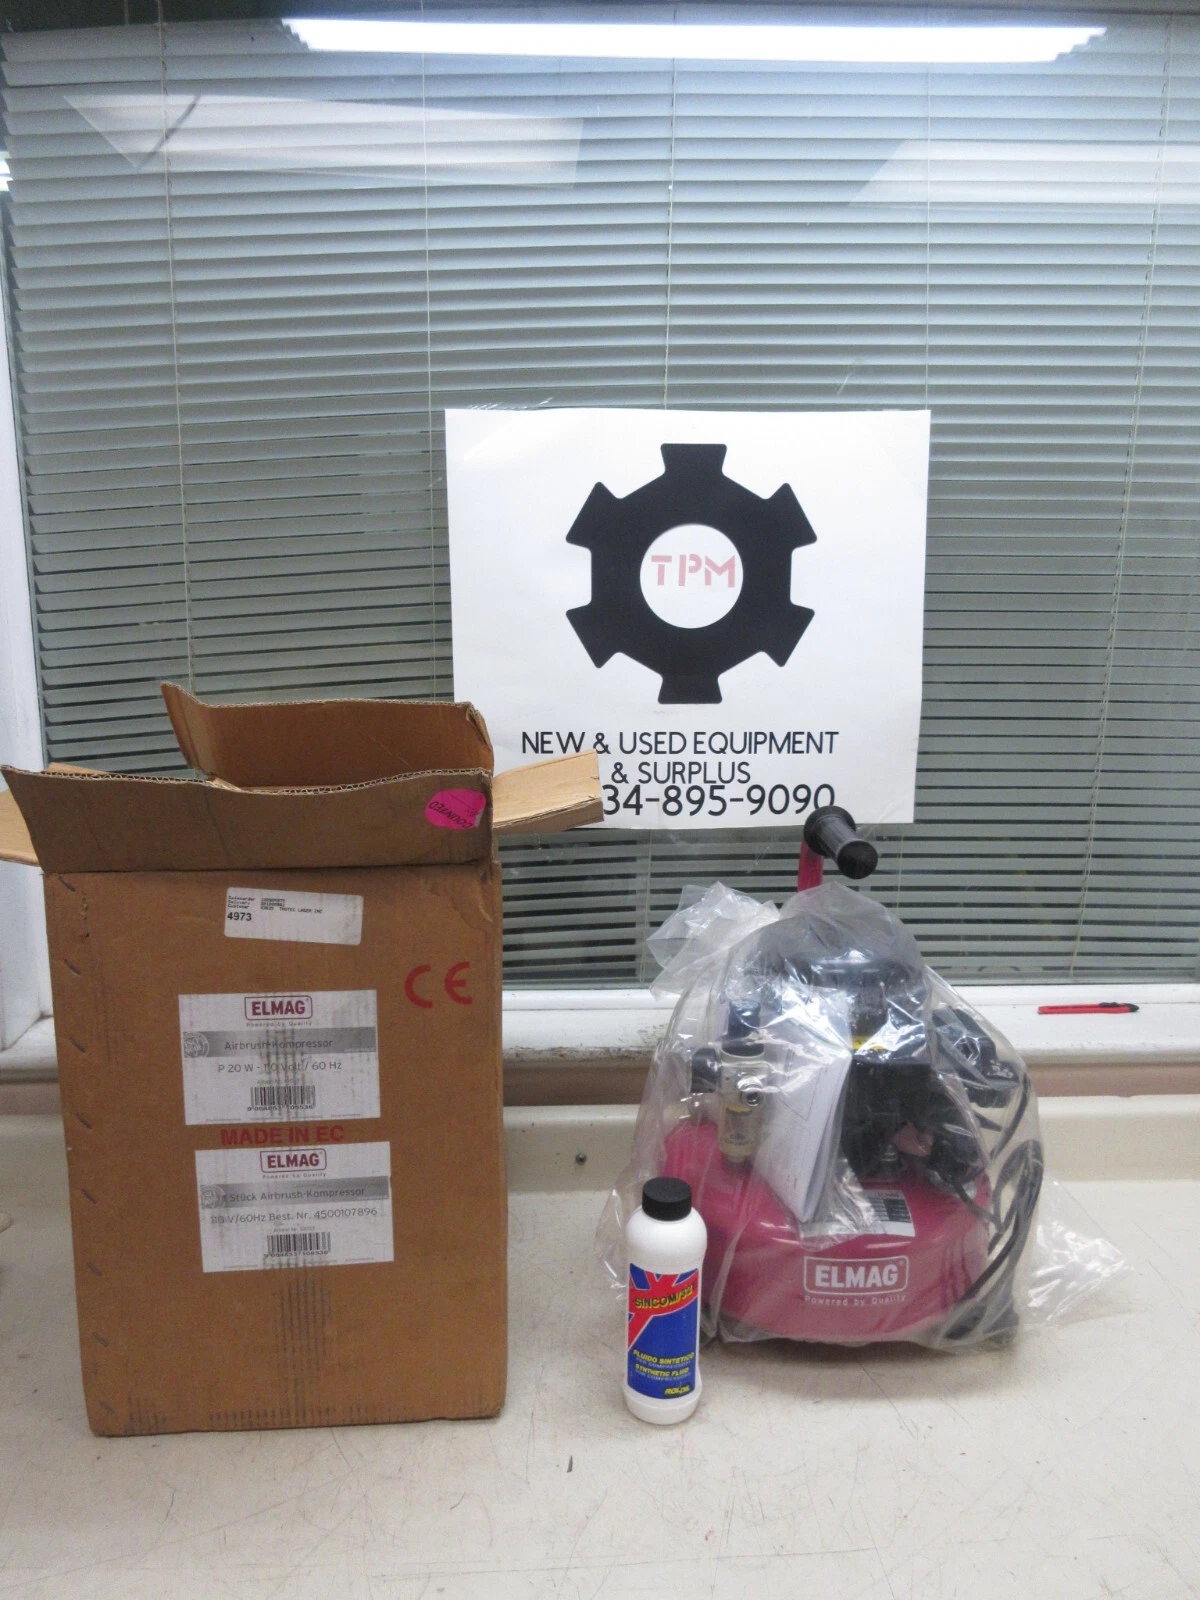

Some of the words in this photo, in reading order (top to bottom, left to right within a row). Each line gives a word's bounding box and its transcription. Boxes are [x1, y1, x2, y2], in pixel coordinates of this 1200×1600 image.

[651, 554, 735, 588] TPM
[522, 732, 585, 754] NEW
[594, 732, 610, 755] &
[619, 732, 687, 755] USED
[694, 731, 839, 755] EQUIPMENT
[611, 761, 629, 784] &
[638, 761, 751, 784] SURPLUS
[602, 783, 836, 816] 34-895-9090
[428, 801, 473, 829] COUNTED
[226, 911, 252, 921] 4973
[404, 961, 473, 1009] CE
[251, 999, 306, 1016] ELMAG
[217, 1064, 225, 1073] P
[228, 1063, 241, 1073] 20
[245, 1063, 254, 1072] W
[312, 1062, 326, 1071] 60
[329, 1061, 342, 1070] Hz
[221, 1126, 282, 1146] MADE
[289, 1125, 309, 1144] IN
[316, 1124, 345, 1143] EC
[267, 1152, 320, 1169] ELMAG
[230, 1191, 257, 1202] Stück
[260, 1187, 365, 1201] Airbrush-Kompressor
[269, 1210, 294, 1221] Best.
[296, 1210, 312, 1220] Nr.
[314, 1207, 378, 1220] 4500107896
[815, 1264, 898, 1288] ELMAG
[805, 1295, 848, 1306] Powered
[854, 1296, 865, 1306] by
[871, 1294, 907, 1305] Quality
[633, 1349, 658, 1364] FLUIDO
[659, 1352, 695, 1365] SINTETICO
[635, 1363, 671, 1377] SYNTHETIC
[671, 1366, 690, 1377] FLUID
